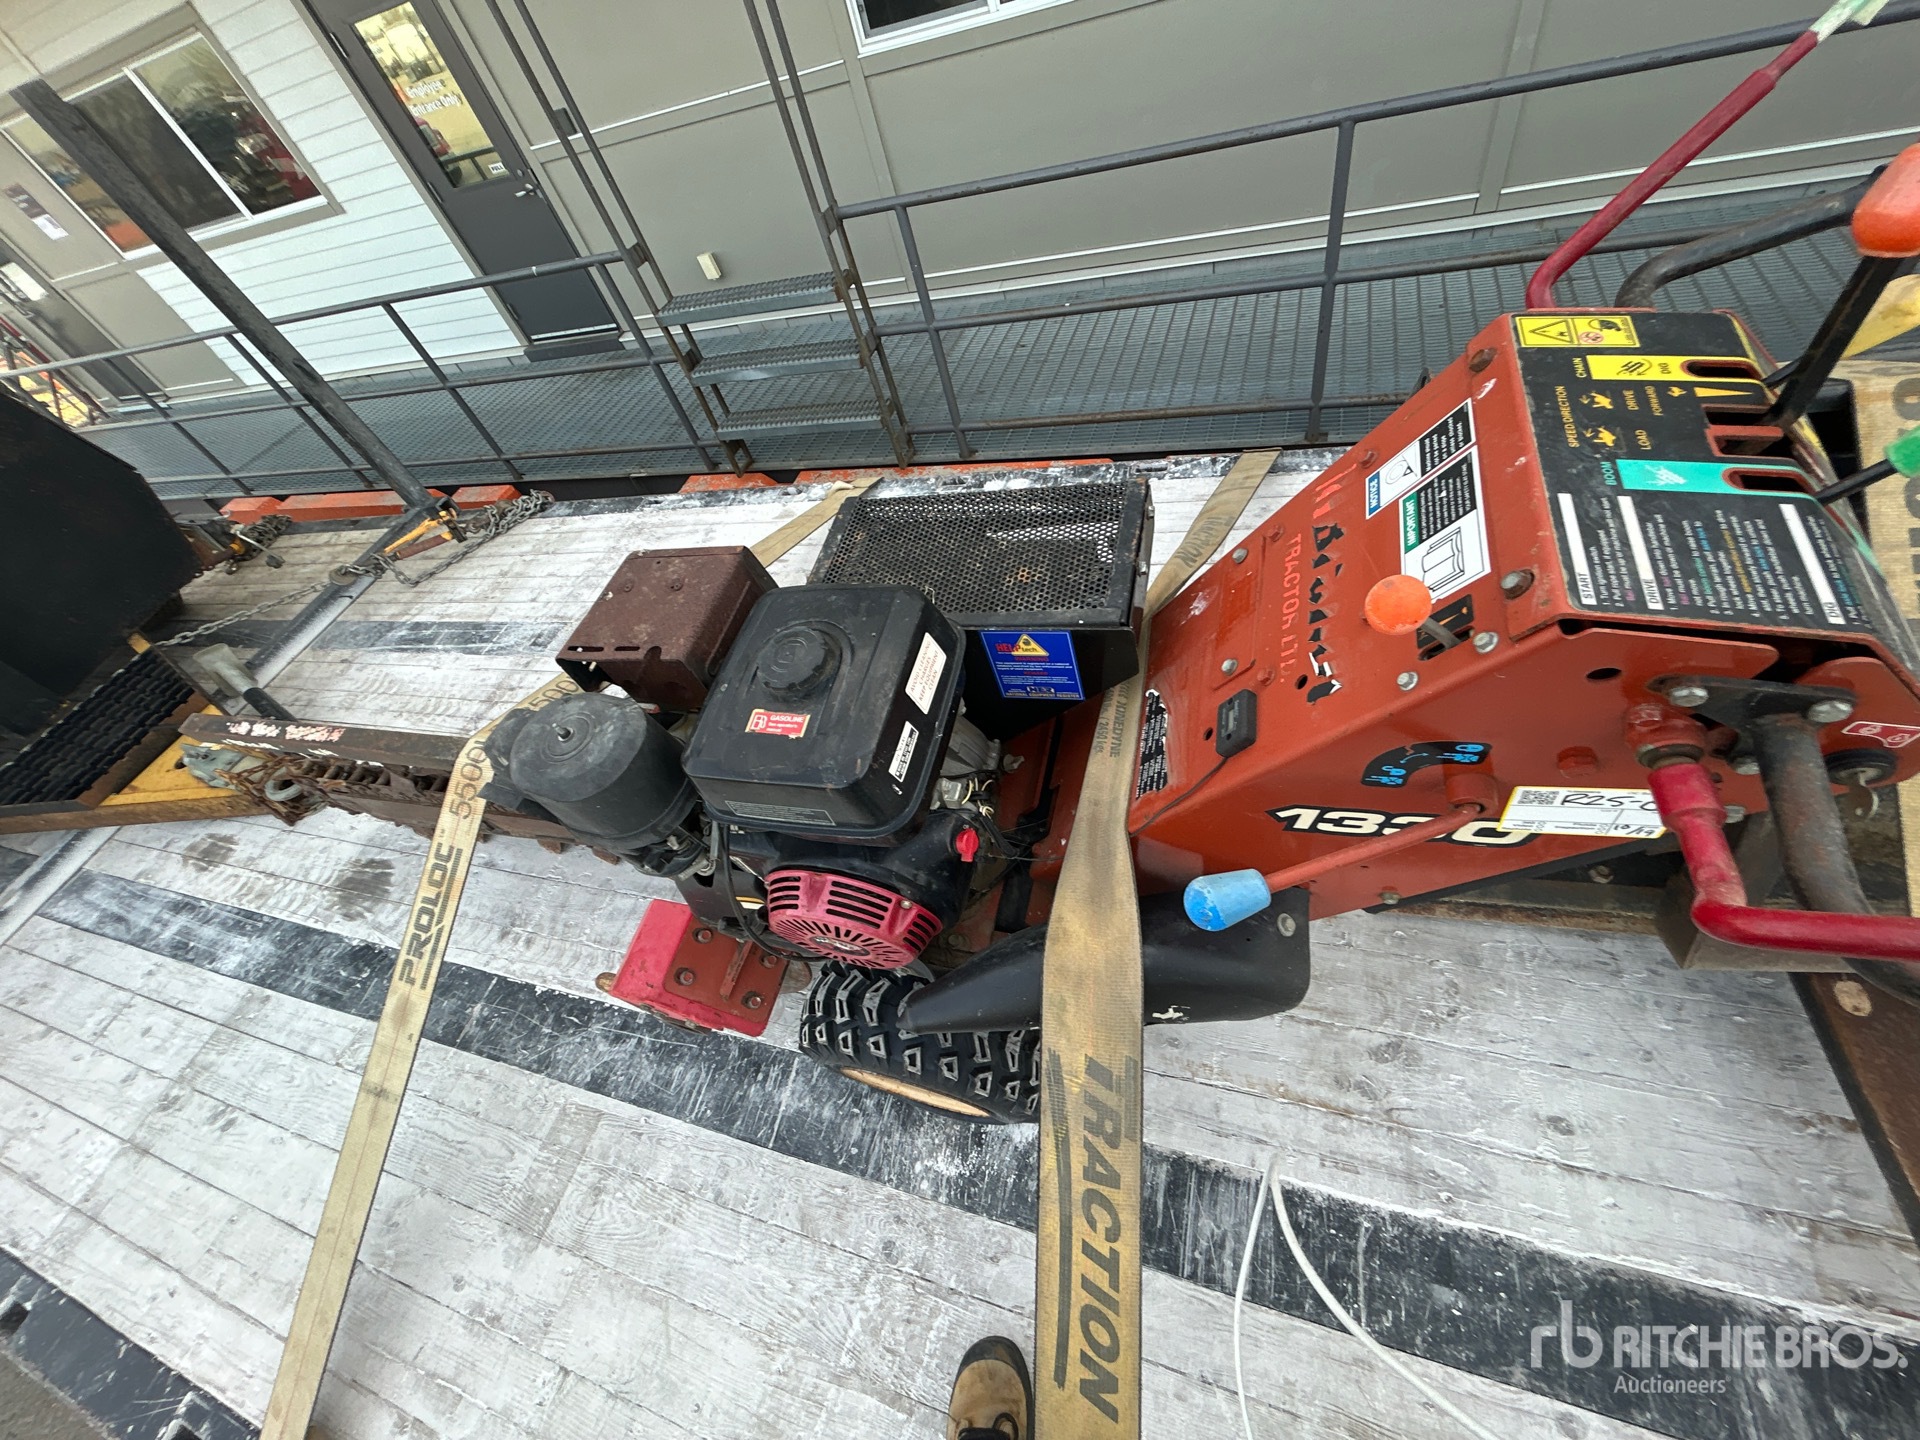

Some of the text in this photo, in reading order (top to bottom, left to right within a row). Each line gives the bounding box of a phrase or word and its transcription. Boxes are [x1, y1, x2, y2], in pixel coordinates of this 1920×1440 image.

[1572, 358, 1587, 378] CHAIN
[1658, 362, 1672, 374] DIG
[1622, 389, 1639, 410] DRIVE
[1644, 386, 1663, 416] FORWARD
[1554, 386, 1580, 448] SPEED DIRECTION
[1635, 430, 1652, 450] LOAD
[1600, 461, 1618, 486] BOOM
[1369, 478, 1378, 509] NOTICE
[1406, 498, 1418, 548] IMPORTANT
[1280, 533, 1302, 630] TRACTOR
[1577, 572, 1592, 599] START
[1642, 578, 1659, 603] DRIVE
[1821, 601, 1840, 617] DIG
[996, 644, 1021, 652] HELP
[910, 640, 932, 694] AVOID CLEANING
[918, 650, 939, 702] KEEP EQUIPMENT
[928, 670, 938, 691] CLEAN
[769, 714, 804, 723] GASOLINE
[398, 843, 455, 986] PROLOC
[1078, 1052, 1121, 1425] TRACTION
